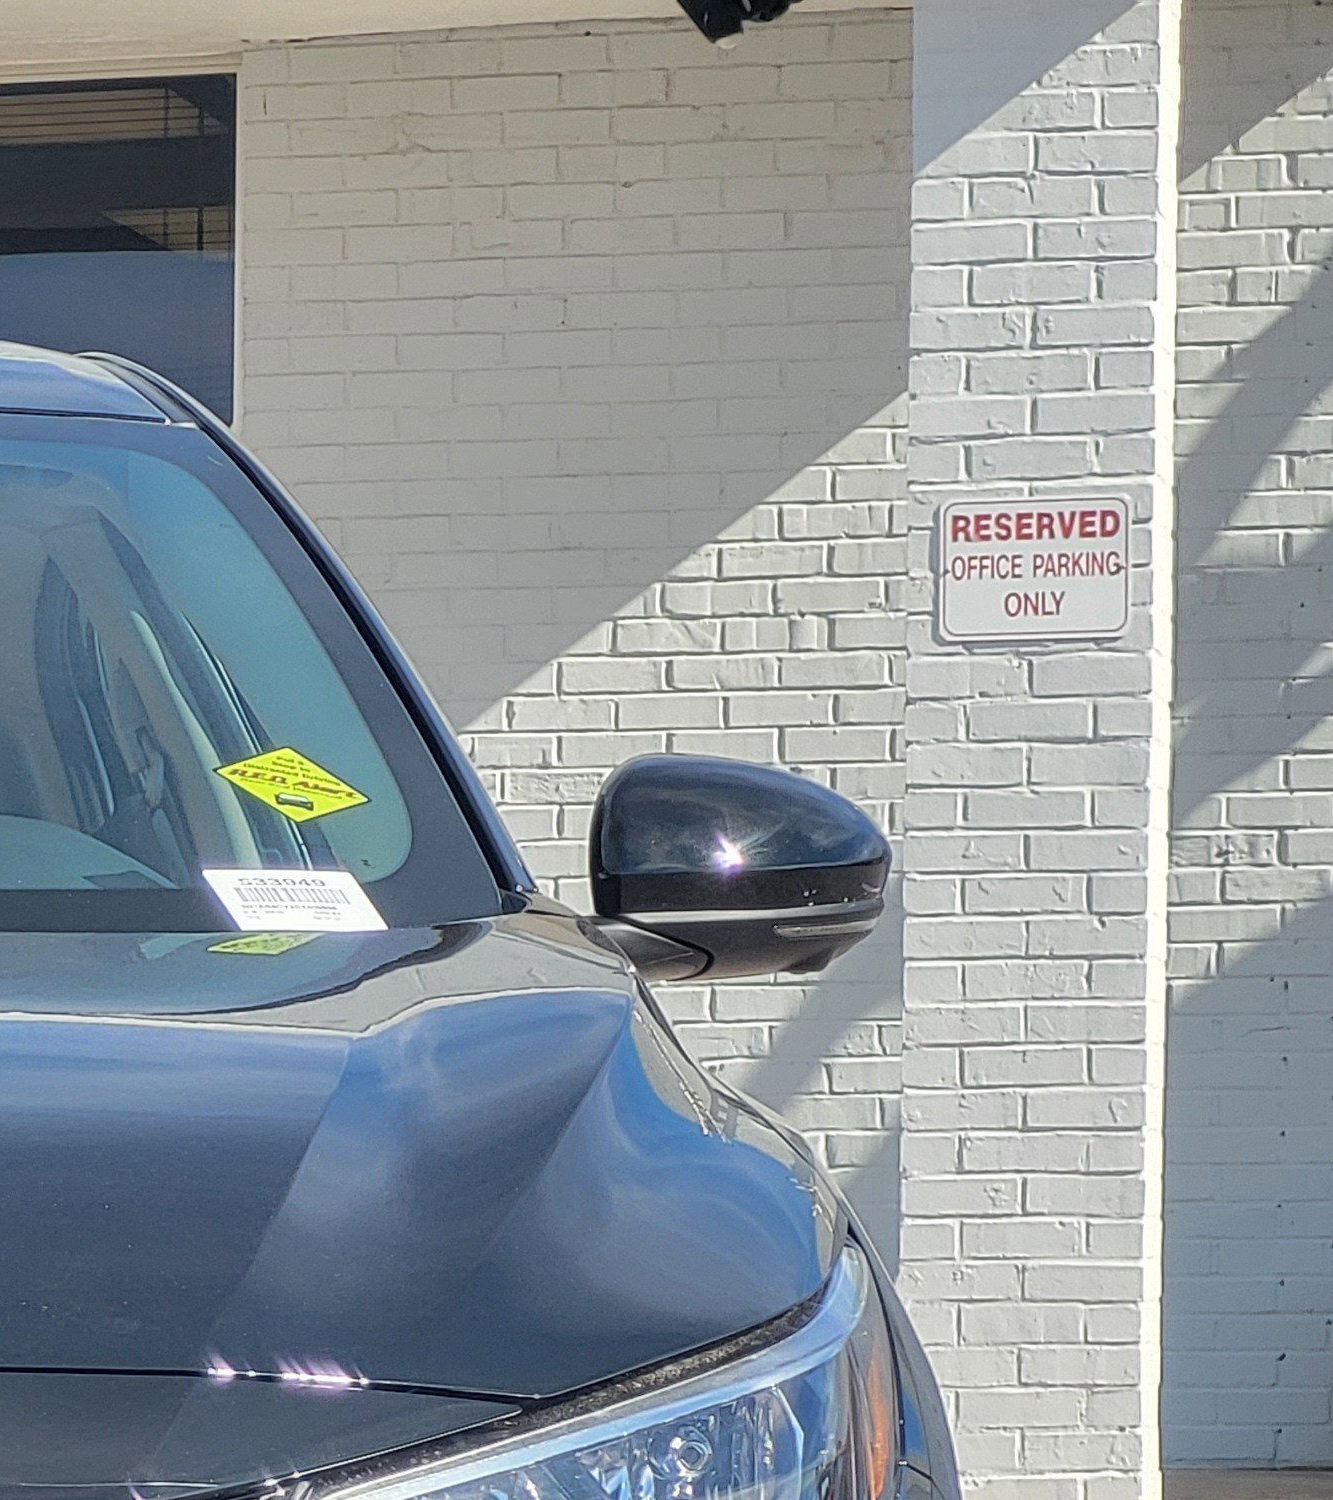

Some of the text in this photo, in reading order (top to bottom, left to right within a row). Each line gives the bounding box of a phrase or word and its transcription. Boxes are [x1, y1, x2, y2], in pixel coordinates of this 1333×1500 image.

[951, 510, 1121, 543] RESERVED
[951, 551, 1121, 581] OFFICE PARKING
[1004, 591, 1066, 618] ONLY
